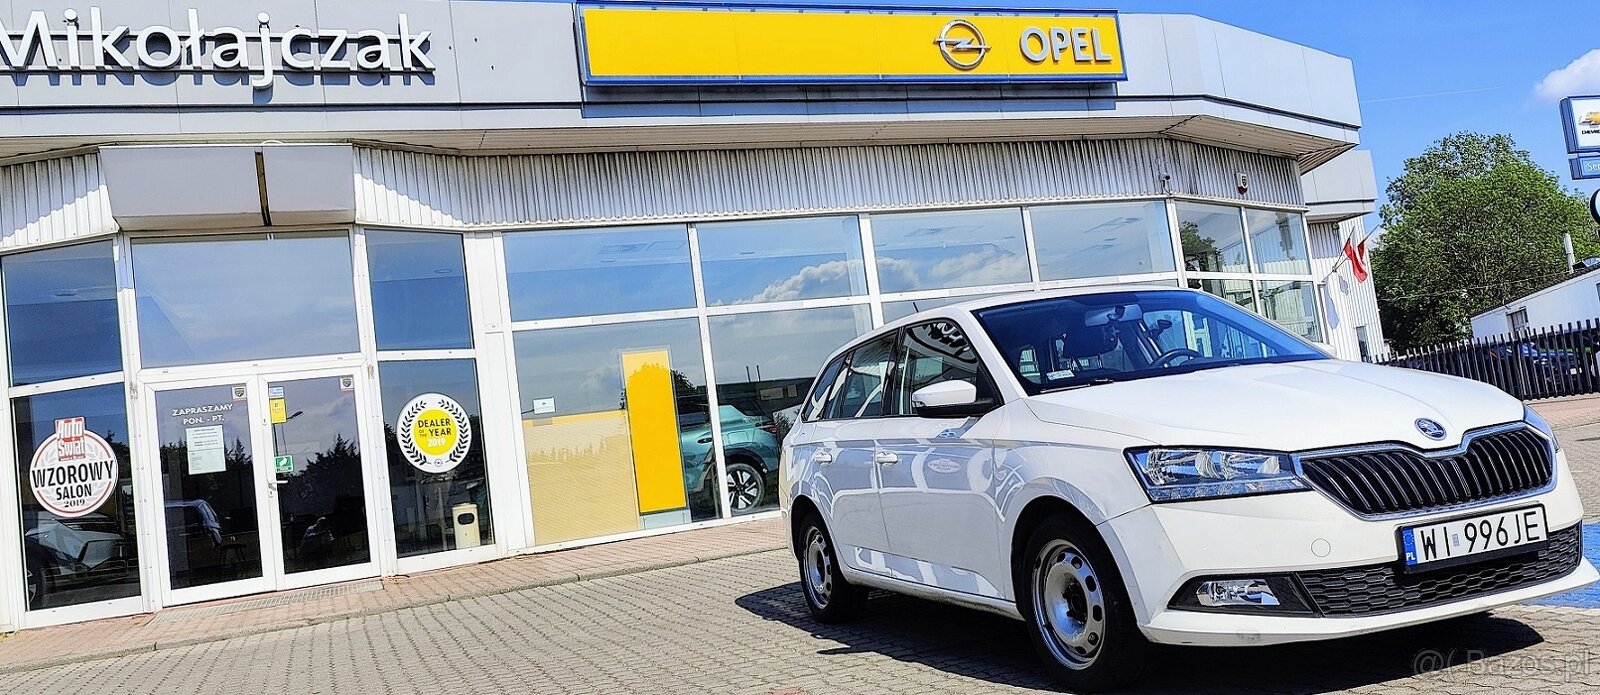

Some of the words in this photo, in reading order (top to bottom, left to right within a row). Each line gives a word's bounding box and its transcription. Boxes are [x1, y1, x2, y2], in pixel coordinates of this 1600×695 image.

[0, 6, 436, 89] Mikołajczak
[1020, 27, 1113, 64] OPEL
[172, 403, 233, 416] ZAPRASZAMY
[183, 417, 205, 425] PON.
[417, 418, 451, 428] DEALER
[428, 428, 452, 437] YEAR
[32, 460, 114, 489] WZOROWY
[56, 483, 92, 501] SALON
[63, 498, 85, 508] 2019
[1405, 552, 1416, 561] PL
